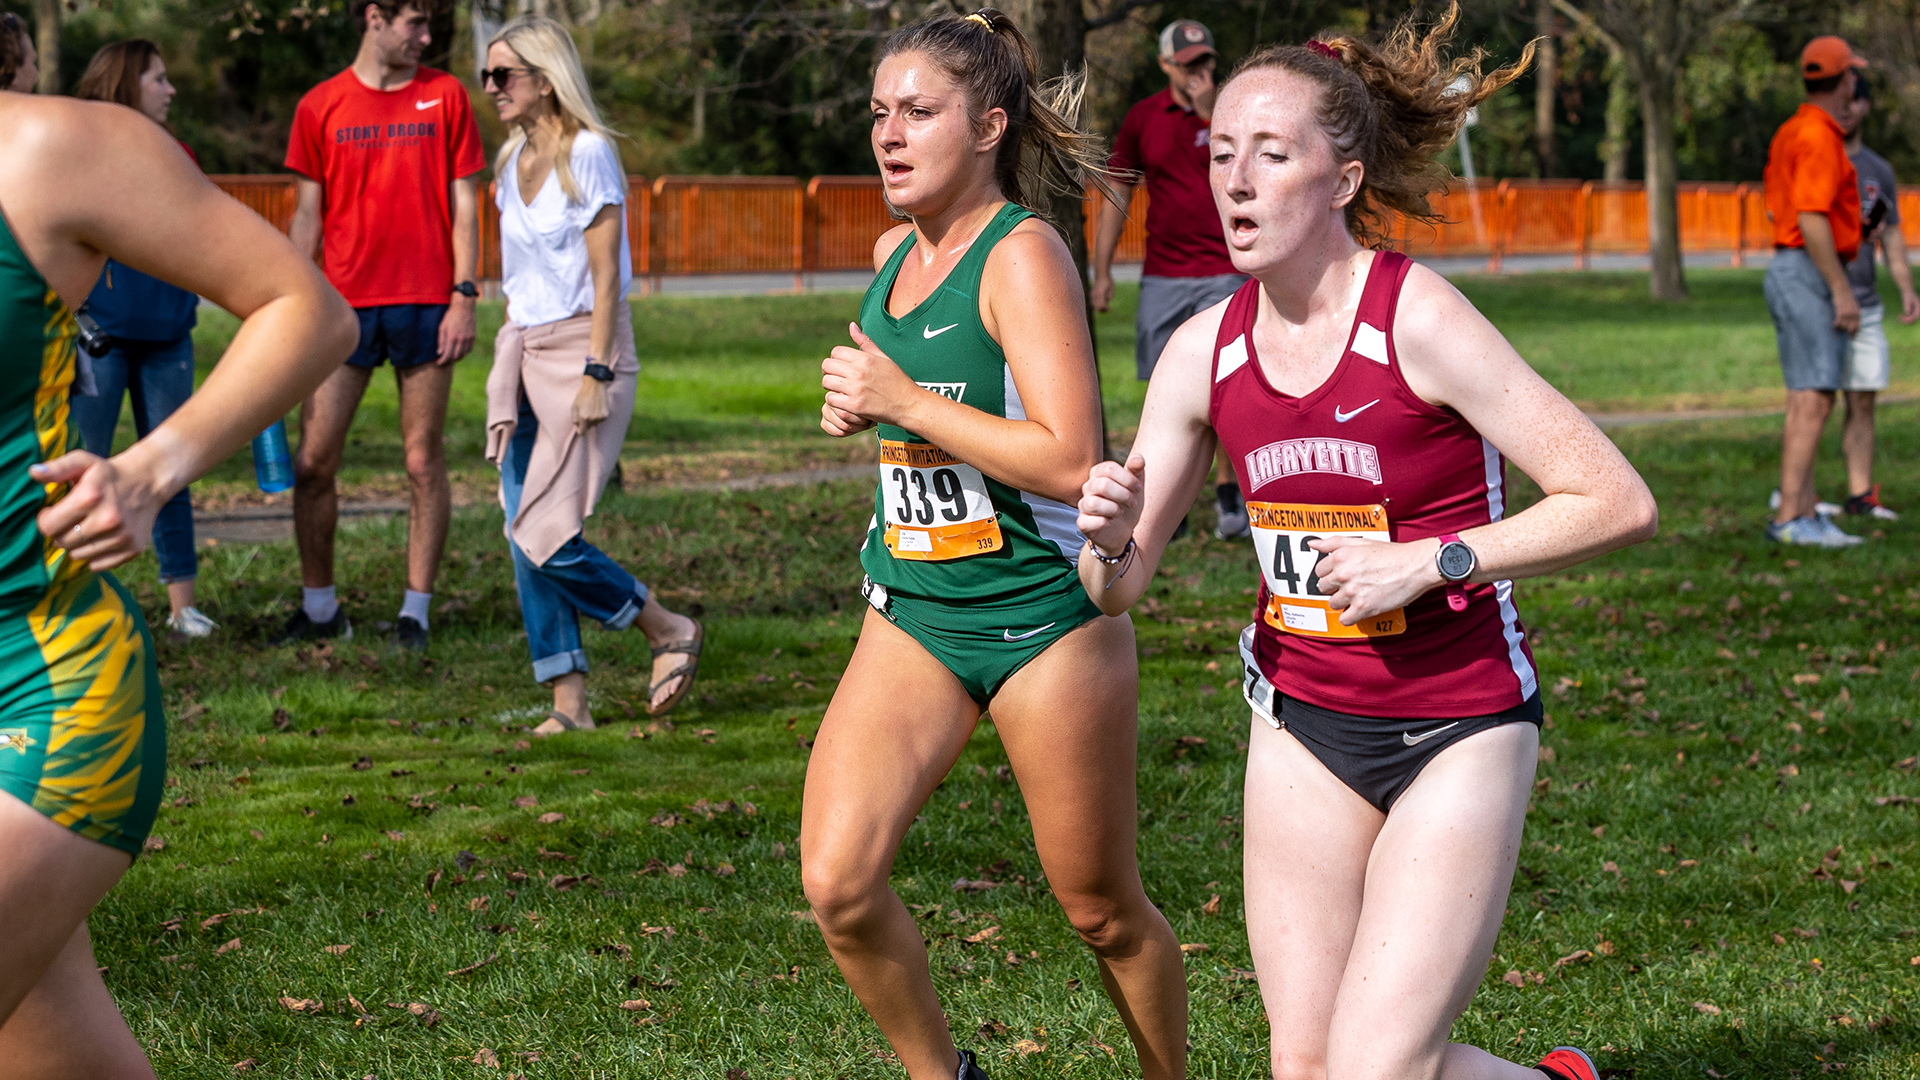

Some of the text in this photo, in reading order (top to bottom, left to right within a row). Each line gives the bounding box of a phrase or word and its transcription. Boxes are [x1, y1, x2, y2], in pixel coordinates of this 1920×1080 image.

[336, 125, 380, 144] STONY
[387, 122, 436, 138] BROOK
[1245, 437, 1382, 491] LAFAYETTE
[892, 467, 968, 526] 339
[1256, 506, 1376, 529] PRINCETON INVITATIONAL
[976, 537, 994, 550] 339
[1273, 534, 1363, 596] 42
[1375, 620, 1393, 632] 427
